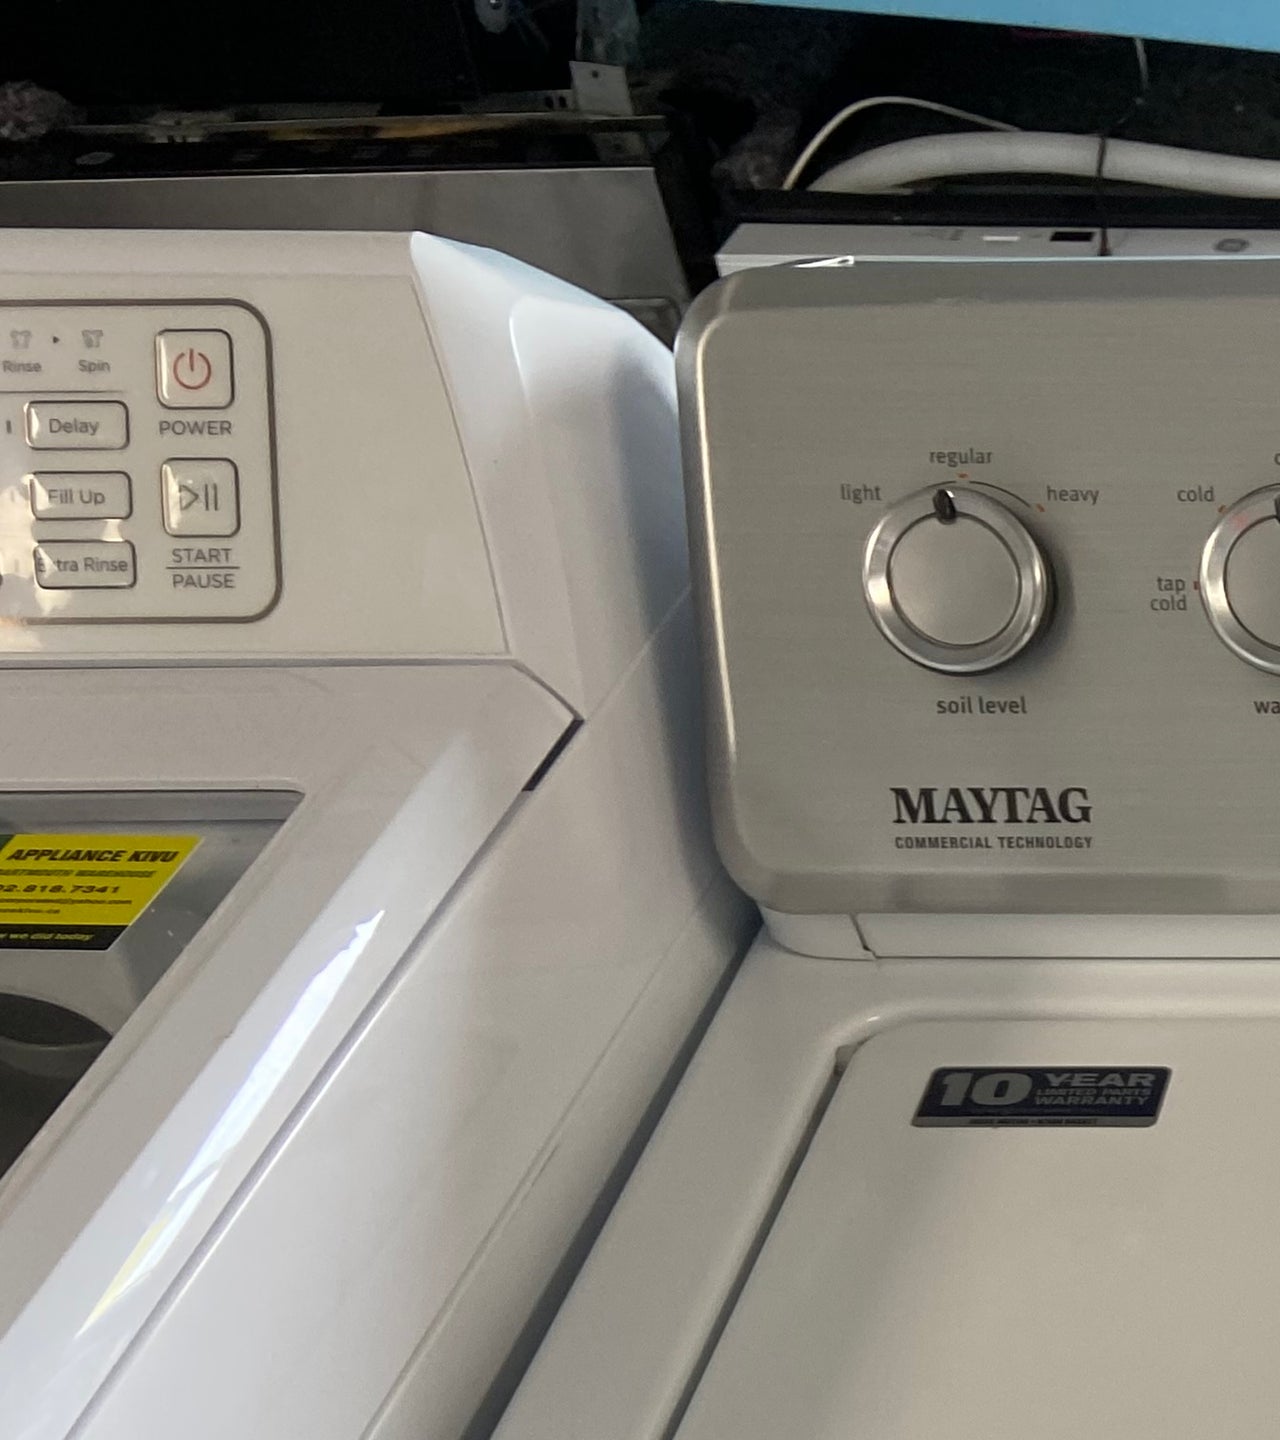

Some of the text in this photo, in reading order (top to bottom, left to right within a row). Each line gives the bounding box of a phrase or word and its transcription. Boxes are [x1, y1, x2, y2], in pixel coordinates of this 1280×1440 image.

[2, 360, 42, 373] Rinse
[78, 359, 111, 373] Spin
[49, 418, 100, 436] Delay
[159, 420, 232, 435] POWER
[929, 448, 993, 468] regular
[48, 489, 105, 506] Fill Up
[840, 483, 882, 503] light
[1046, 485, 1099, 505] heavy
[1177, 486, 1214, 502] cold
[172, 548, 232, 563] START
[37, 558, 128, 573] Etra Rinse
[173, 574, 235, 588] PAUSE
[1156, 576, 1186, 595] tap
[1150, 594, 1187, 611] cold
[936, 696, 1027, 714] soil level
[890, 786, 1093, 824] MAYTAG
[895, 835, 1093, 849] COMMERCIAL TECHNOLOGY
[7, 849, 179, 862] APPLIANCE KIVU
[941, 1073, 1156, 1106] 10 YEAR
[1036, 1088, 1096, 1096] LIMITED
[1036, 1096, 1150, 1105] WARRANTY
